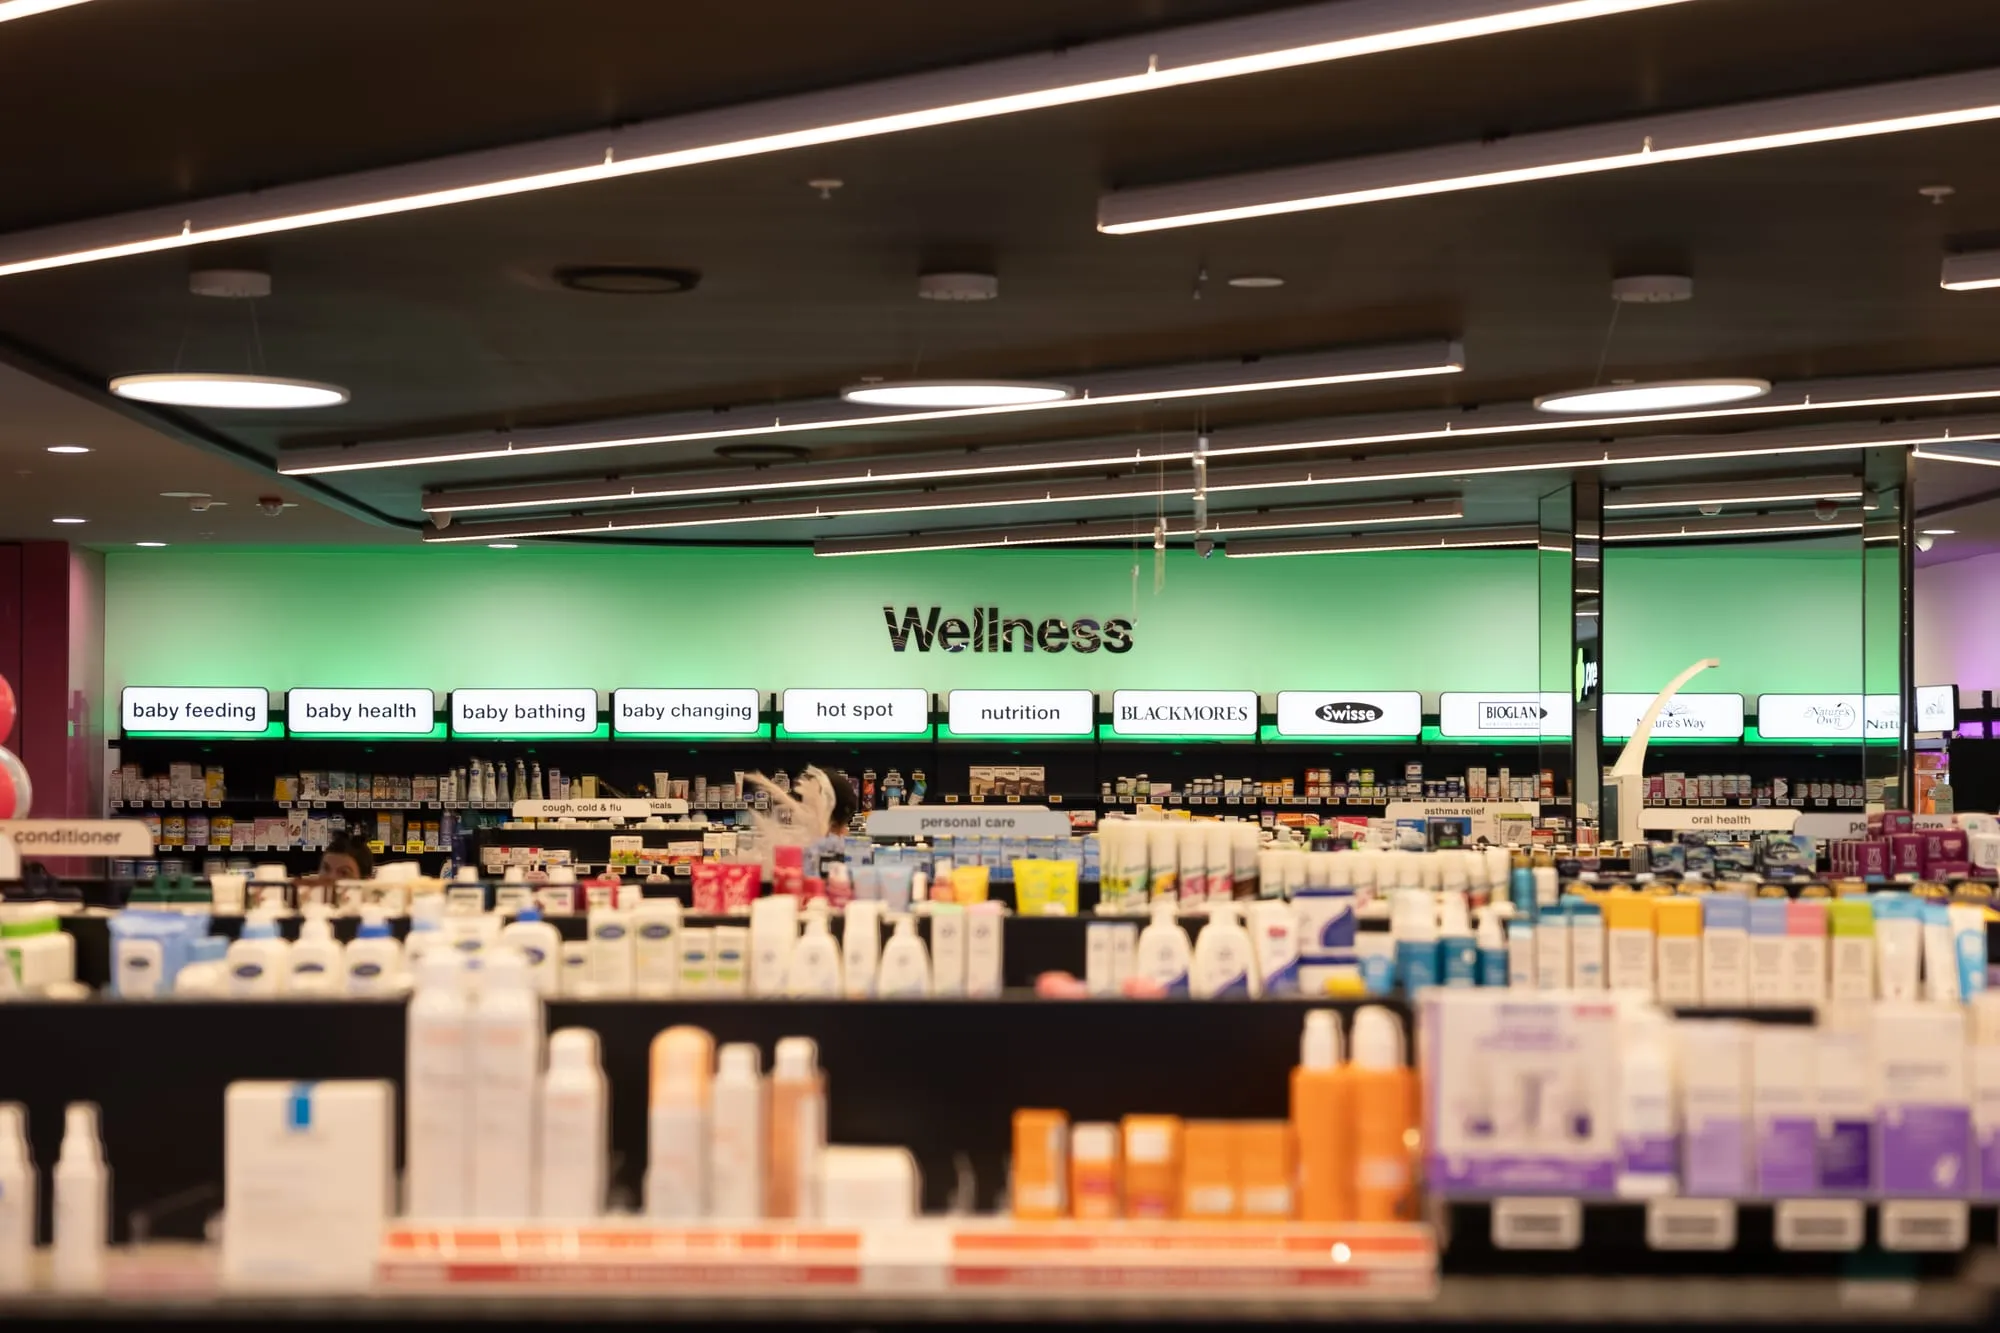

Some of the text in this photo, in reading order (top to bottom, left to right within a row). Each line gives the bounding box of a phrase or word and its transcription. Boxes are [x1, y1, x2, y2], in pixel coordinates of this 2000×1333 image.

[883, 605, 1134, 654] Wellness
[133, 702, 257, 722] baby feeding
[305, 703, 417, 722] baby health
[462, 704, 586, 723] baby bathing
[622, 702, 753, 721] baby changing
[816, 702, 893, 721] hot spot
[981, 704, 1061, 721] nutrition
[1121, 705, 1248, 721] BLACKMORES
[1323, 704, 1376, 721] Swisse
[1486, 706, 1537, 719] BIOGLAN
[1812, 706, 1850, 716] Nature's
[1683, 718, 1706, 731] Way
[1816, 715, 1842, 727] Own
[542, 802, 622, 813] cough, cold & flu
[1424, 806, 1485, 816] asthma relief
[921, 815, 1016, 831] personal care
[1690, 814, 1751, 825] oral health
[13, 827, 122, 845] conditioner
